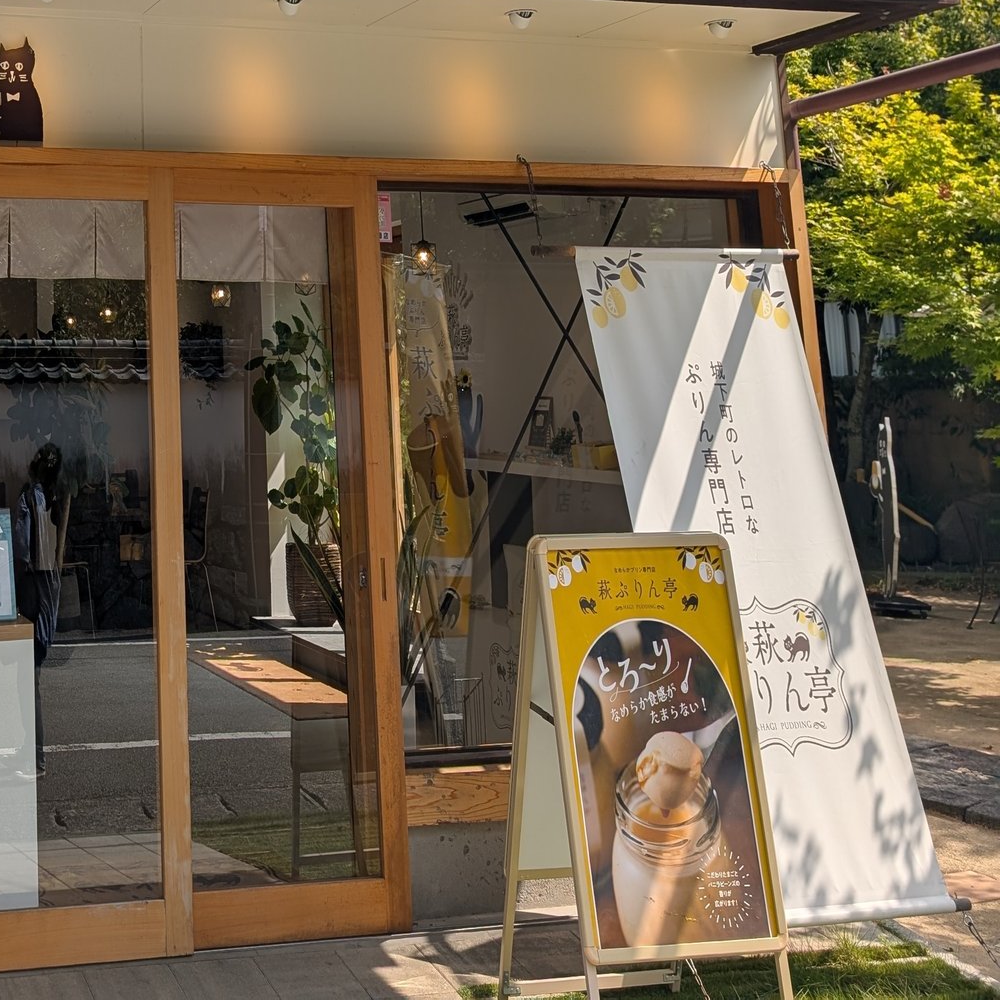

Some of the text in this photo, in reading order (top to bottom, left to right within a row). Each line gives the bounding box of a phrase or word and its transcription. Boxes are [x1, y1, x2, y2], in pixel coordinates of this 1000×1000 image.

[686, 363, 736, 536] ぷりん専門店
[709, 361, 760, 536] 城下町のレトロな
[597, 577, 679, 600] 萩ぷりん亭
[748, 620, 784, 666] 萩
[610, 683, 677, 722] なめらか食感が
[754, 666, 837, 714] りん亭
[760, 720, 813, 731] HAGI PUDDING
